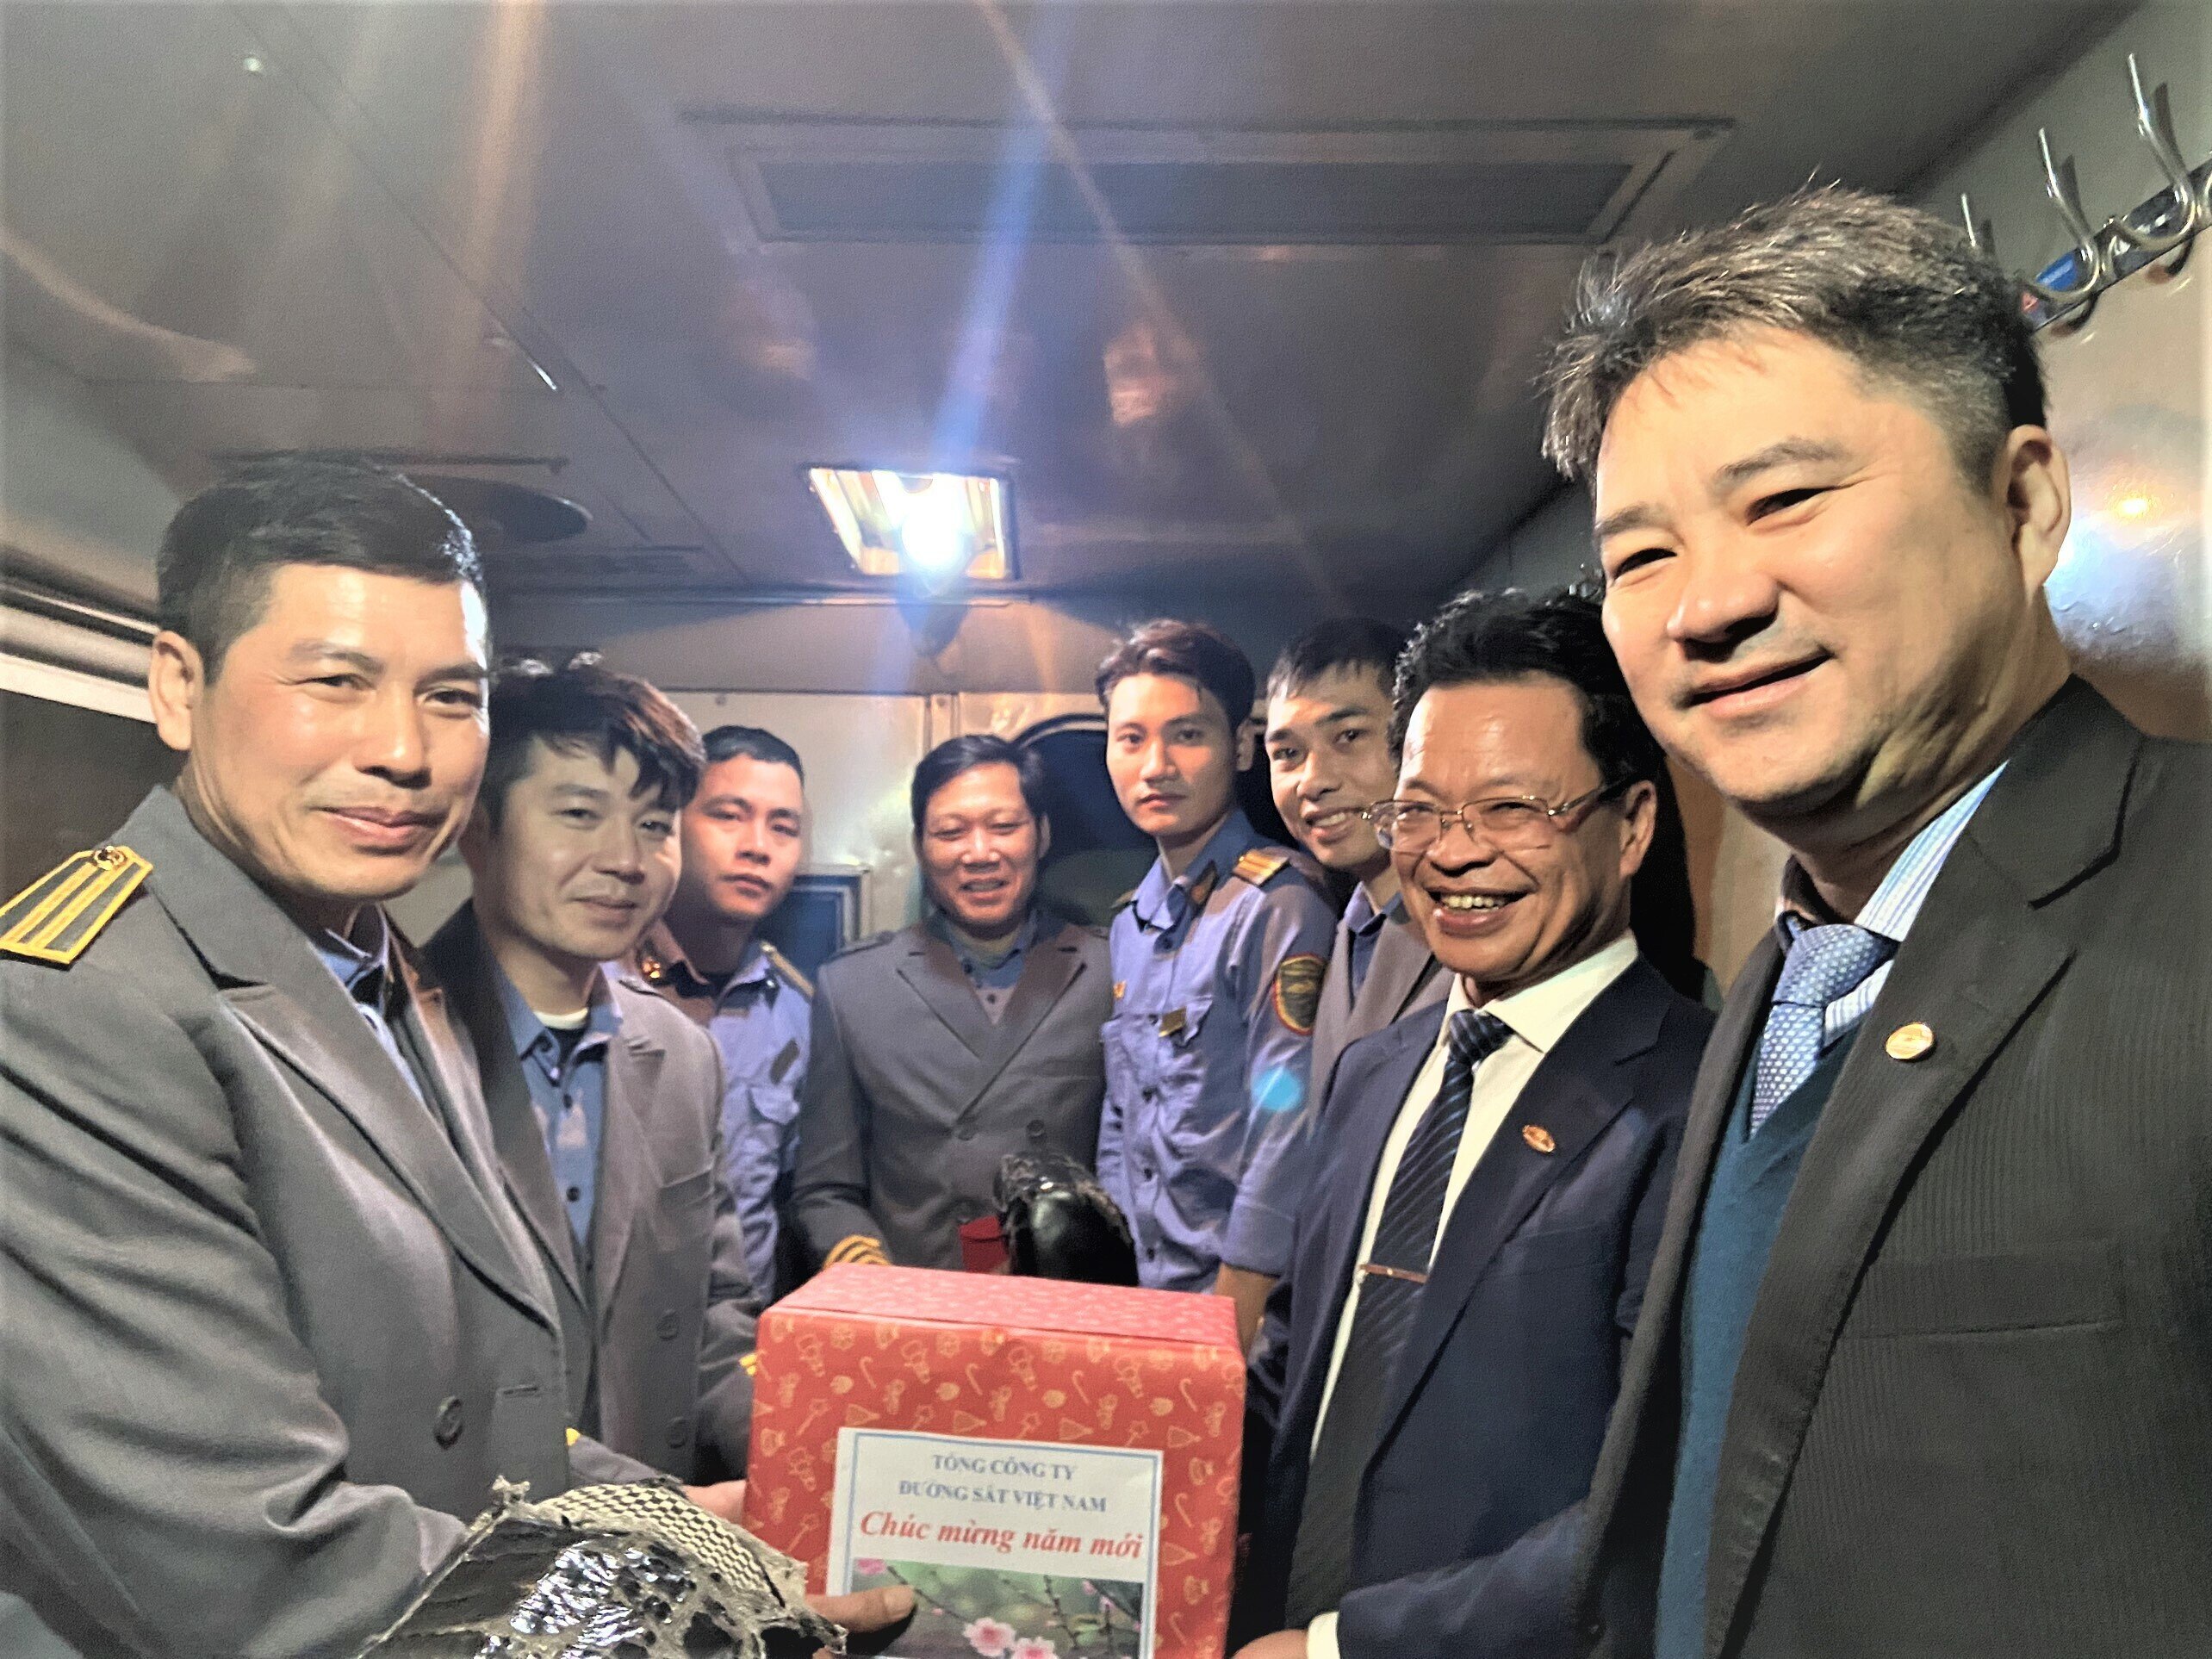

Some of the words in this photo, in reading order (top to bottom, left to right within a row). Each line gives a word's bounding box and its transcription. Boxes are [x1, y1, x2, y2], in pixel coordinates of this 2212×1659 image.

[991, 1456, 1047, 1478] CÔNG
[1052, 1464, 1077, 1480] TY
[1063, 1494, 1106, 1513] NAM
[861, 1511, 931, 1540] Chúc
[937, 1519, 1016, 1553] mừng
[1022, 1528, 1082, 1553] năm
[1090, 1532, 1144, 1559] mới
